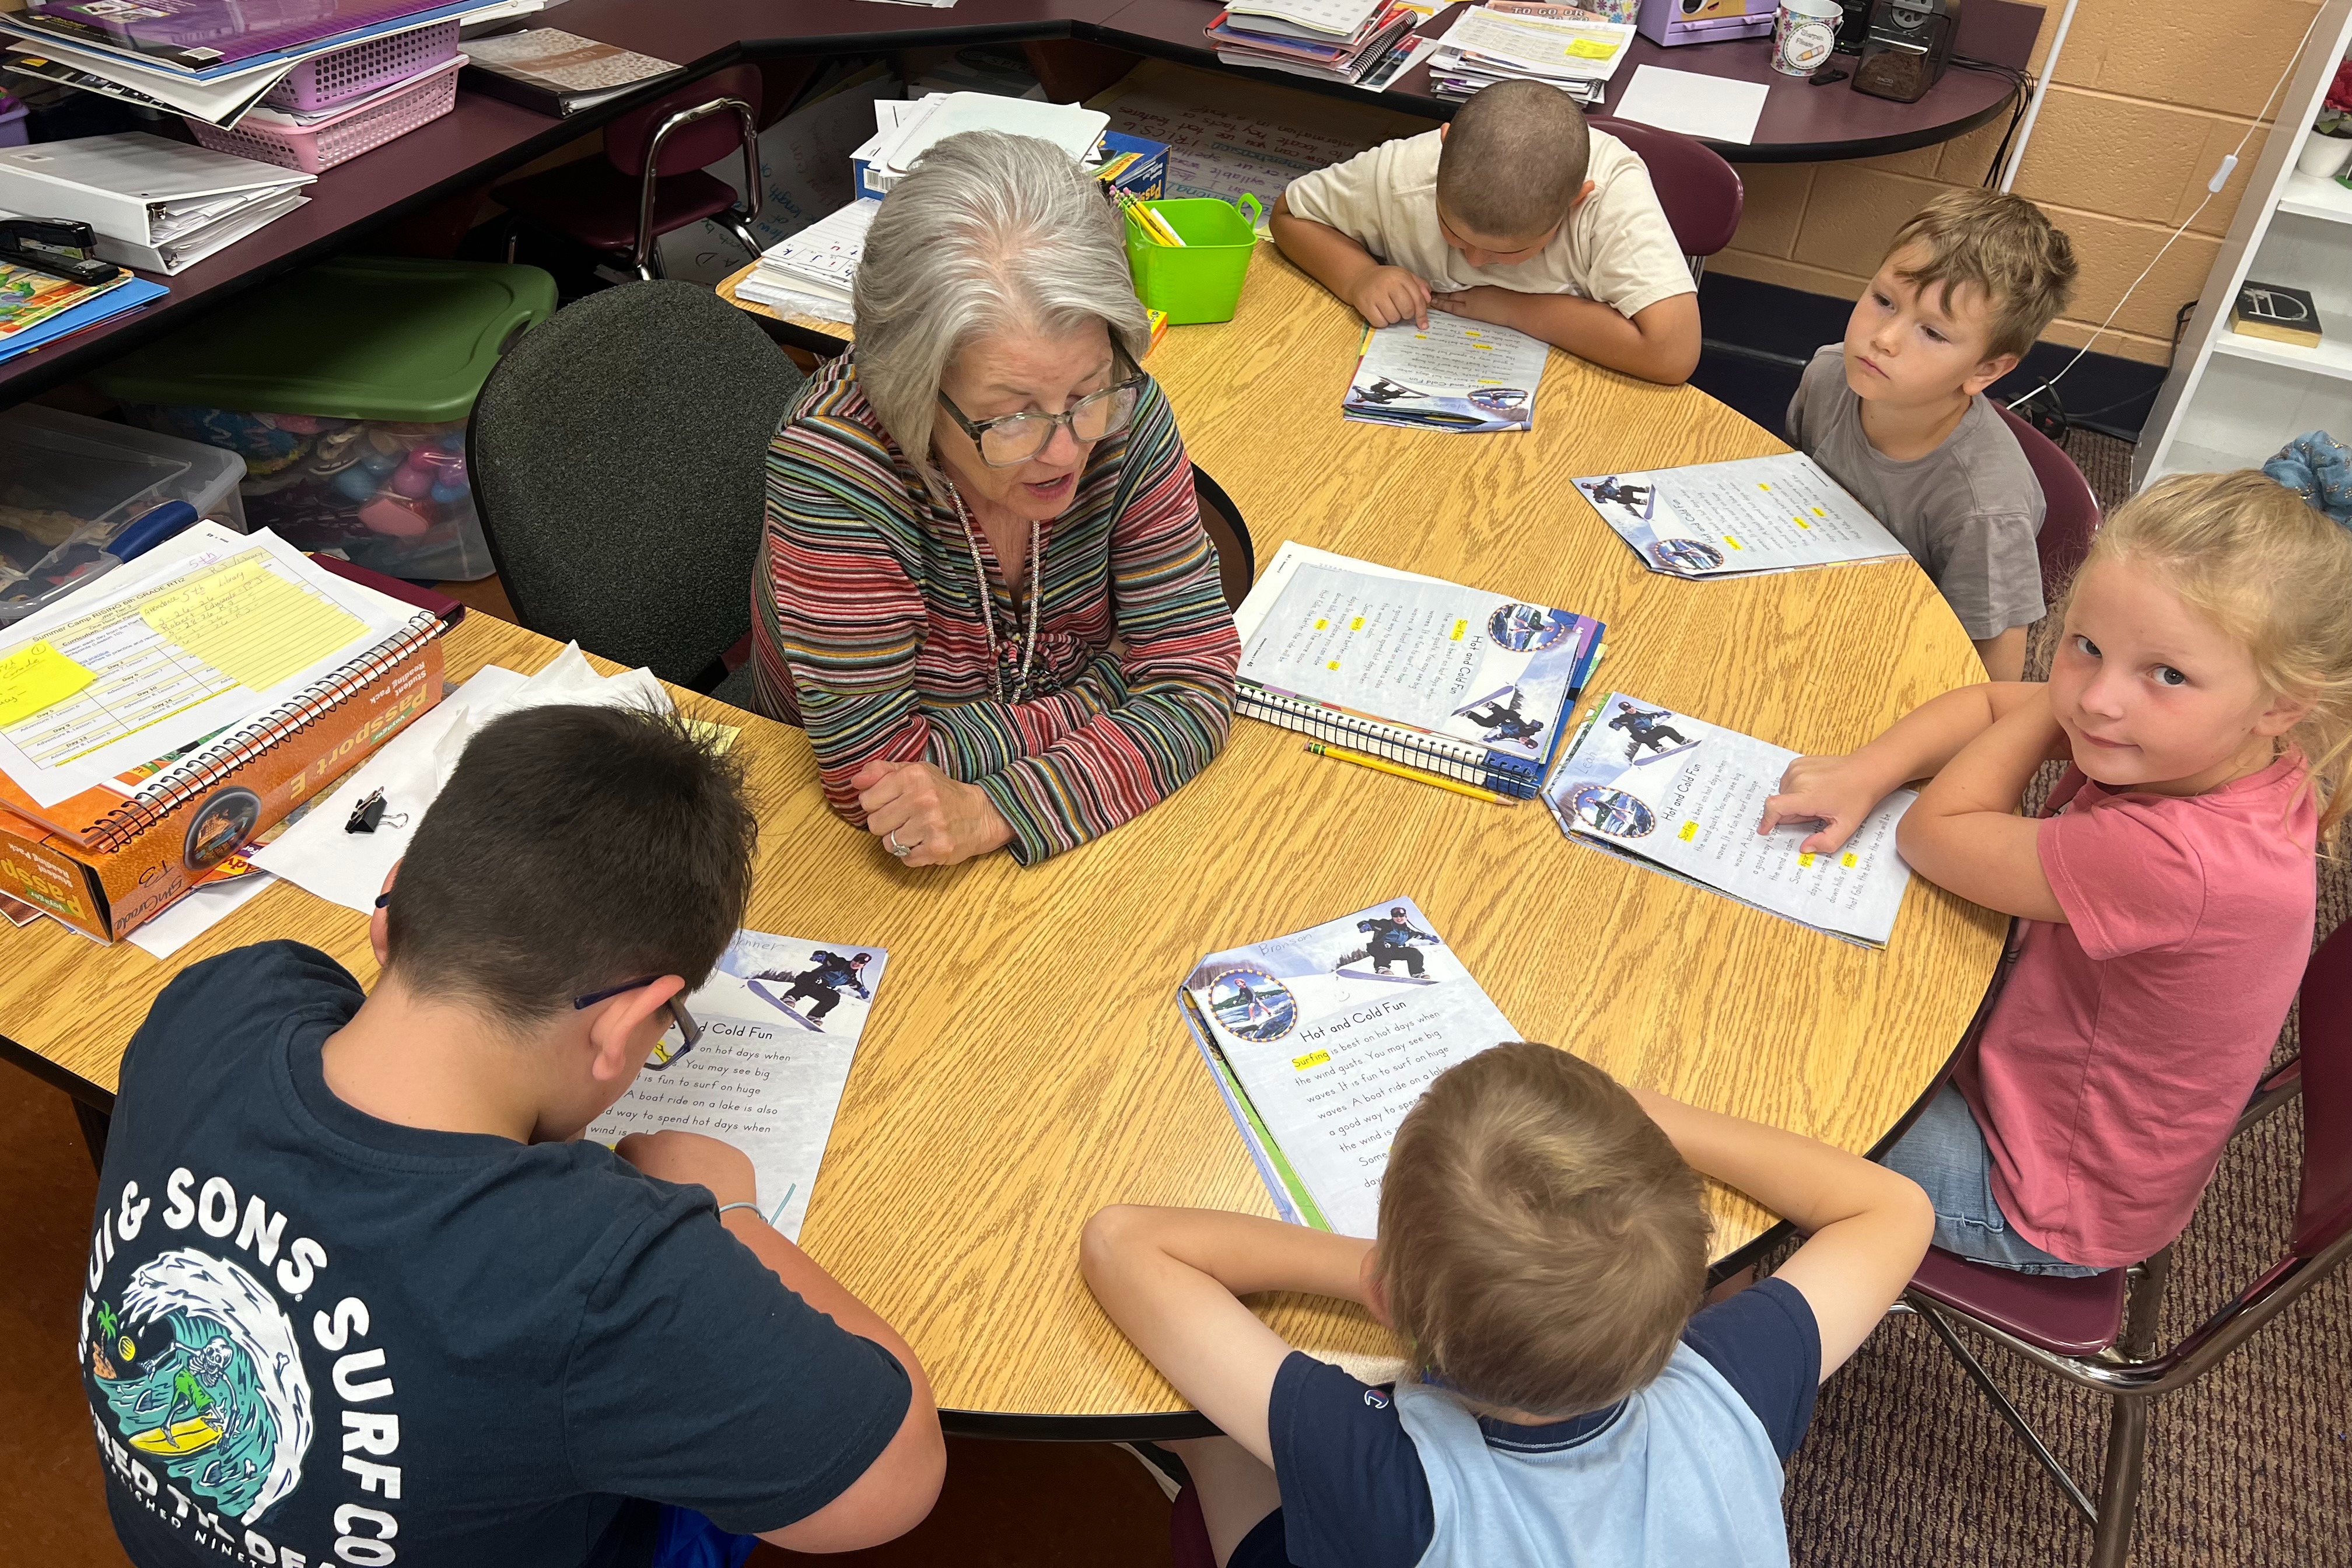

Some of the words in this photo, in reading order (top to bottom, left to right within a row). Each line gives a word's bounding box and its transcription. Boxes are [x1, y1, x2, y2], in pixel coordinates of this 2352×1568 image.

[1678, 509, 1695, 522] Cold
[1690, 522, 1705, 532] and
[1700, 533, 1716, 544] Hot
[32, 626, 65, 642] Summer
[66, 616, 92, 628] Camp
[90, 602, 122, 618] RISING
[122, 596, 136, 605] 6th
[136, 585, 165, 599] GRADE
[1448, 619, 1468, 641] Surfing
[1469, 635, 1483, 650] Hot
[1462, 652, 1472, 666] and
[392, 661, 425, 688] Reading
[394, 670, 426, 697] Student
[1455, 666, 1471, 683] Cold
[369, 686, 390, 704] Pack
[1449, 682, 1464, 694] Fun
[316, 683, 428, 776] Passport
[374, 715, 405, 740] Voyager
[1575, 750, 1597, 774] Leah
[1685, 762, 1702, 776] Fun
[1714, 760, 1727, 773] when
[290, 771, 306, 800] E
[1676, 775, 1695, 793] Cold
[1707, 774, 1722, 786] days
[1730, 772, 1745, 781] big
[1700, 785, 1713, 795] hot
[1728, 781, 1737, 791] see
[1673, 793, 1685, 806] and
[1722, 790, 1735, 803] may
[1727, 820, 1739, 830] fun
[1738, 798, 1748, 813] surf
[1745, 780, 1761, 793] huge
[1661, 806, 1677, 821] Hot
[1690, 802, 1704, 816] best
[1712, 802, 1726, 813] You
[1676, 821, 1699, 841] Surfing
[1702, 828, 1712, 842] wind
[8, 842, 32, 860] Pack
[1694, 843, 1706, 853] the
[32, 853, 69, 879] Reading
[138, 859, 175, 888] T3
[37, 864, 73, 888] Student
[1788, 867, 1804, 884] Some
[31, 892, 65, 912] Voyager
[1258, 933, 1312, 956] Bronson
[1299, 1026, 1325, 1042] Hot
[1329, 1018, 1351, 1032] and
[1352, 1006, 1382, 1023] Cold
[1381, 1001, 1406, 1013] Fun
[712, 1023, 746, 1036] Cold
[748, 1026, 772, 1040] Fun
[1291, 1052, 1331, 1068] Surfing
[1338, 1037, 1360, 1051] best
[1373, 1026, 1391, 1038] hot
[1394, 1021, 1415, 1031] days
[1417, 1012, 1440, 1023] when
[715, 1045, 733, 1055] hot
[736, 1047, 760, 1061] days
[764, 1051, 790, 1061] when
[1294, 1076, 1311, 1086] the
[1314, 1065, 1336, 1080] wind
[1364, 1051, 1385, 1059] You
[1387, 1043, 1406, 1054] may
[1408, 1037, 1423, 1045] see
[1423, 1030, 1442, 1040] big
[685, 1058, 704, 1070] You
[707, 1065, 729, 1076] may
[754, 1067, 770, 1081] big
[1337, 1080, 1348, 1091] It
[1360, 1073, 1378, 1082] fun
[1378, 1067, 1390, 1076] to
[1392, 1056, 1412, 1071] surf
[1425, 1046, 1448, 1058] huge
[657, 1074, 674, 1085] fun
[678, 1076, 690, 1087] to
[693, 1080, 719, 1089] surf
[736, 1083, 761, 1098] huge
[1352, 1097, 1363, 1107] A
[1362, 1087, 1385, 1102] boat
[1388, 1081, 1406, 1093] ride
[1409, 1077, 1421, 1085] on
[622, 1089, 634, 1098] A
[638, 1090, 664, 1102] boat
[667, 1095, 688, 1105] ride
[718, 1100, 740, 1111] lake
[756, 1105, 778, 1115] also
[617, 1110, 638, 1122] way
[642, 1110, 653, 1120] to
[657, 1114, 690, 1125] spend
[691, 1115, 710, 1126] hot
[713, 1118, 738, 1132] days
[743, 1122, 771, 1132] when
[1338, 1118, 1361, 1136] good
[1363, 1112, 1382, 1123] way
[1383, 1106, 1395, 1114] to
[1398, 1098, 1420, 1111] spen
[590, 1125, 617, 1135] wind
[1339, 1142, 1356, 1152] the
[1359, 1130, 1382, 1144] wind
[1358, 1152, 1387, 1167] Some
[118, 1180, 150, 1241] &
[163, 1167, 328, 1294] SONS
[313, 1296, 401, 1500] SURF
